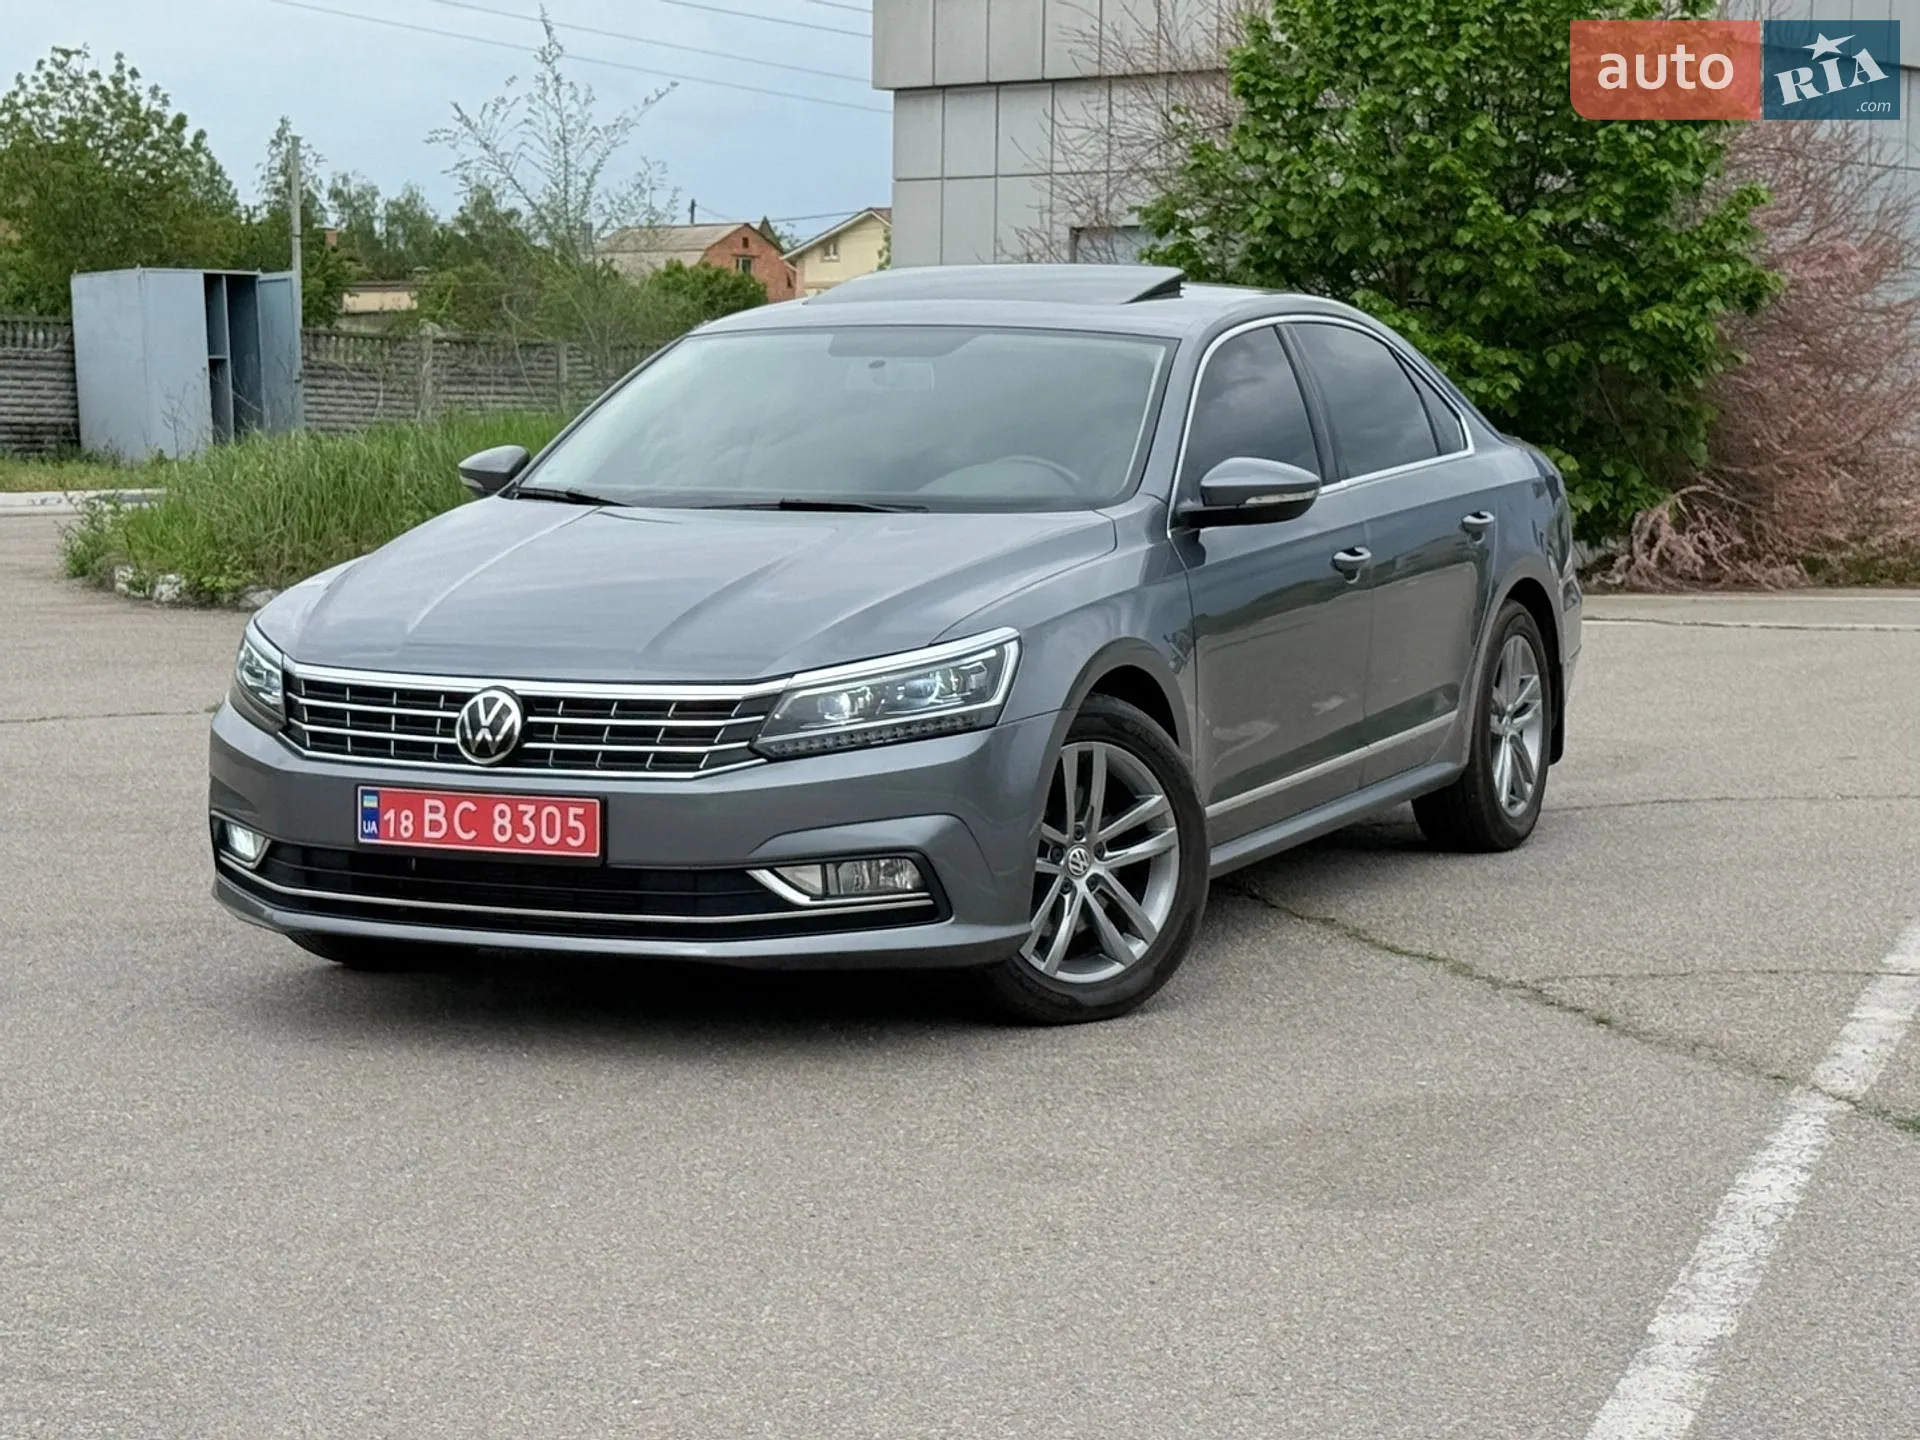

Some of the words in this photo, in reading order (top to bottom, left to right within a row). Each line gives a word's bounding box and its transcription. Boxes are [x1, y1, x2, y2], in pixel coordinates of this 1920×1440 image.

[459, 692, 519, 760] VW
[362, 821, 379, 835] UA
[384, 809, 414, 838] 18
[424, 799, 478, 841] BC
[493, 803, 586, 847] 8305
